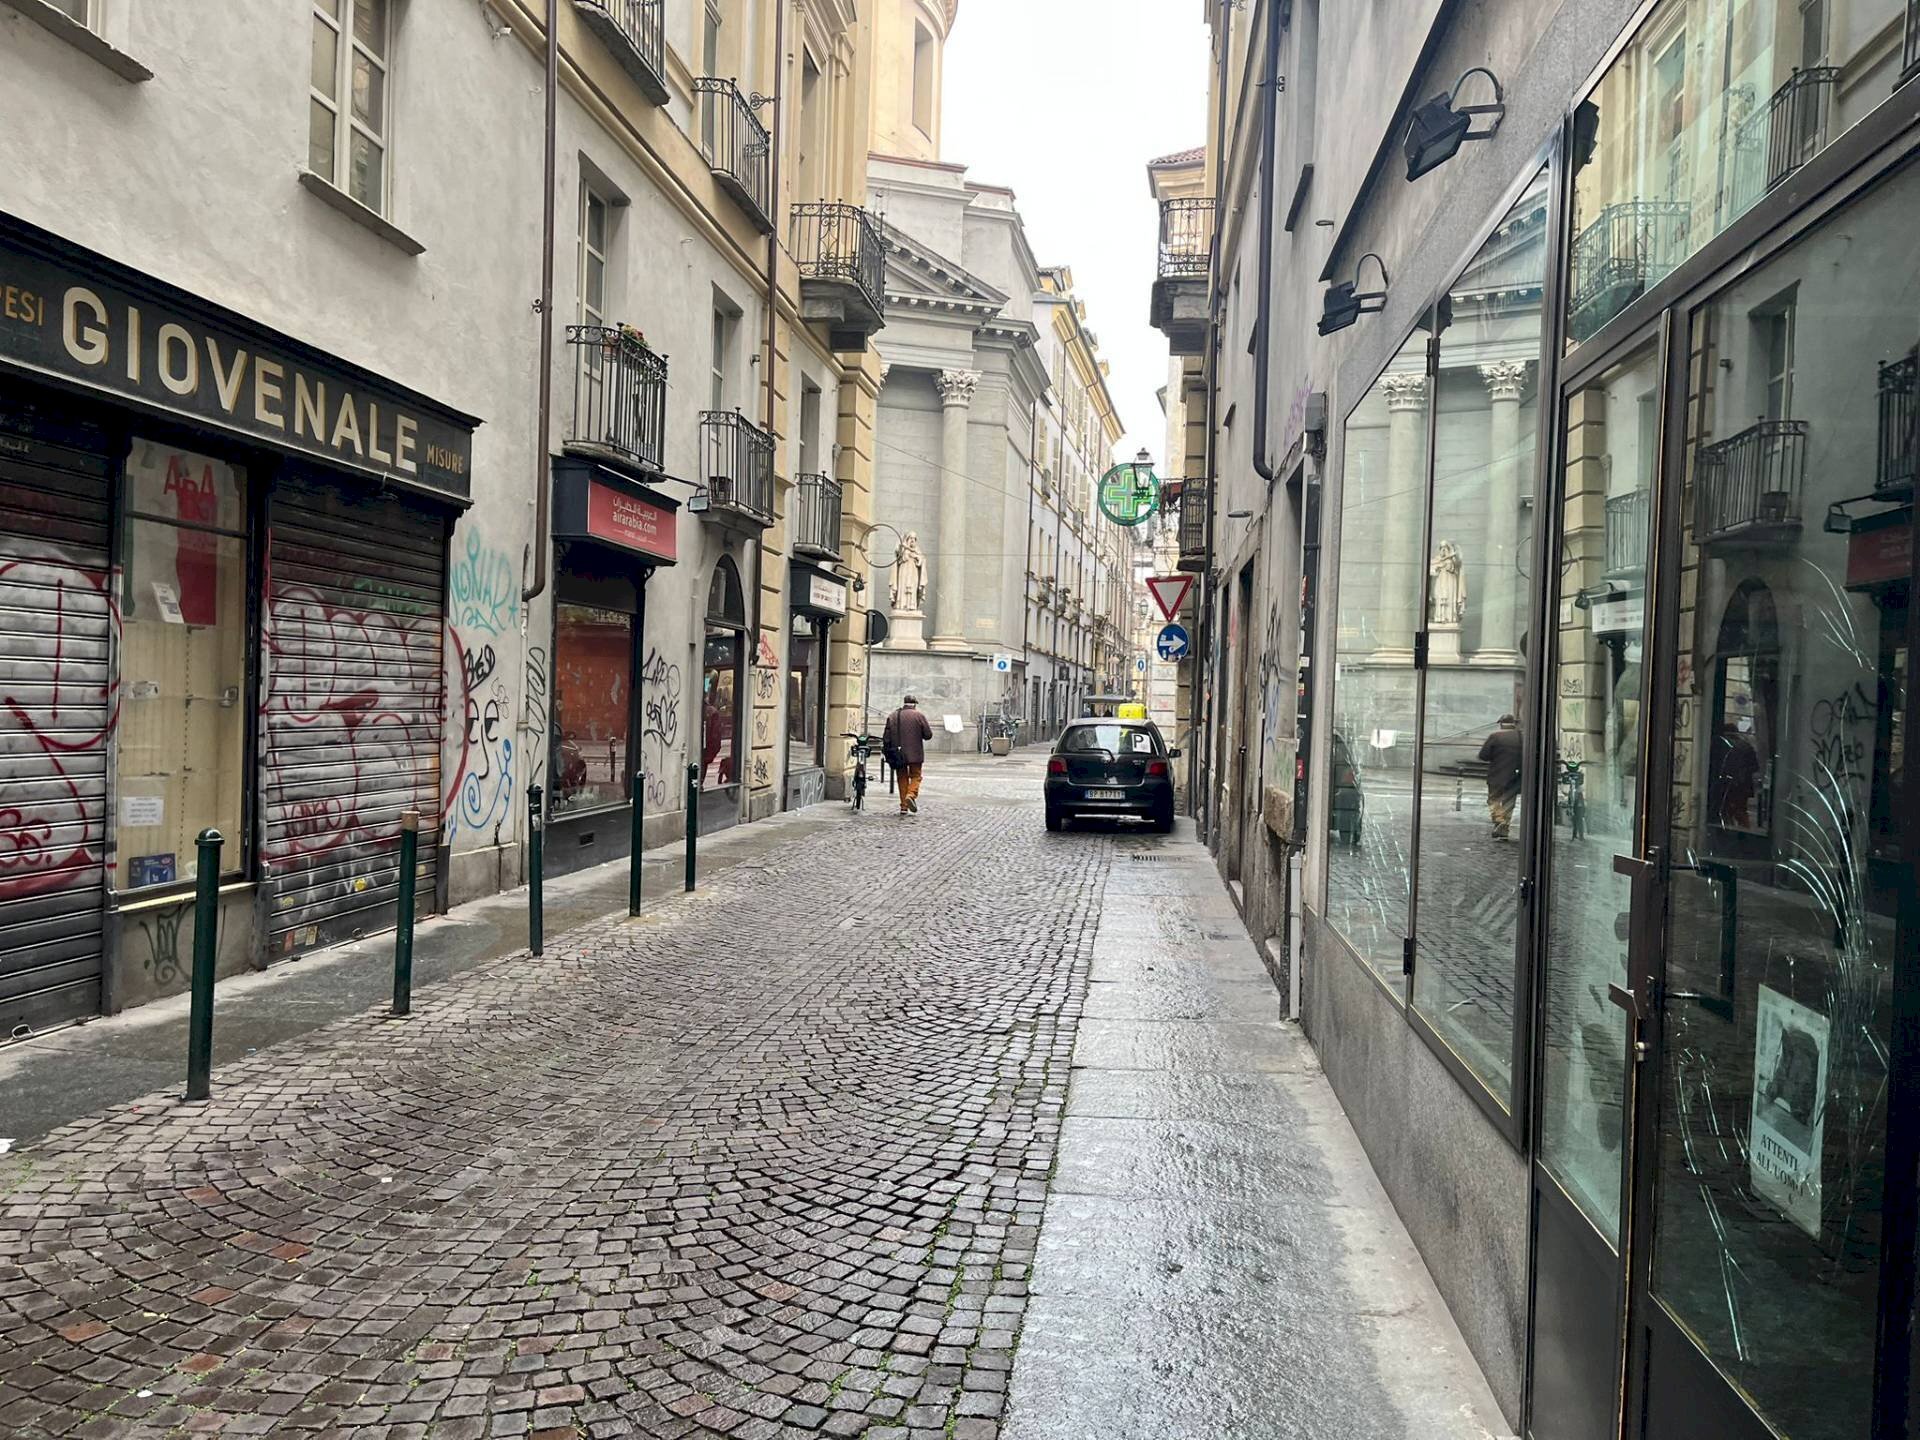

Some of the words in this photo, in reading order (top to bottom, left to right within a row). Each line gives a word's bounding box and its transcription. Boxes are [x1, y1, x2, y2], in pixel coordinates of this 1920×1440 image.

[0, 284, 44, 326] ESI
[62, 286, 419, 473] GIOVENALE
[426, 443, 465, 475] MISURE
[613, 511, 657, 535] airarabia.com
[1133, 734, 1144, 749] P
[1760, 1134, 1798, 1172] ATTENTI
